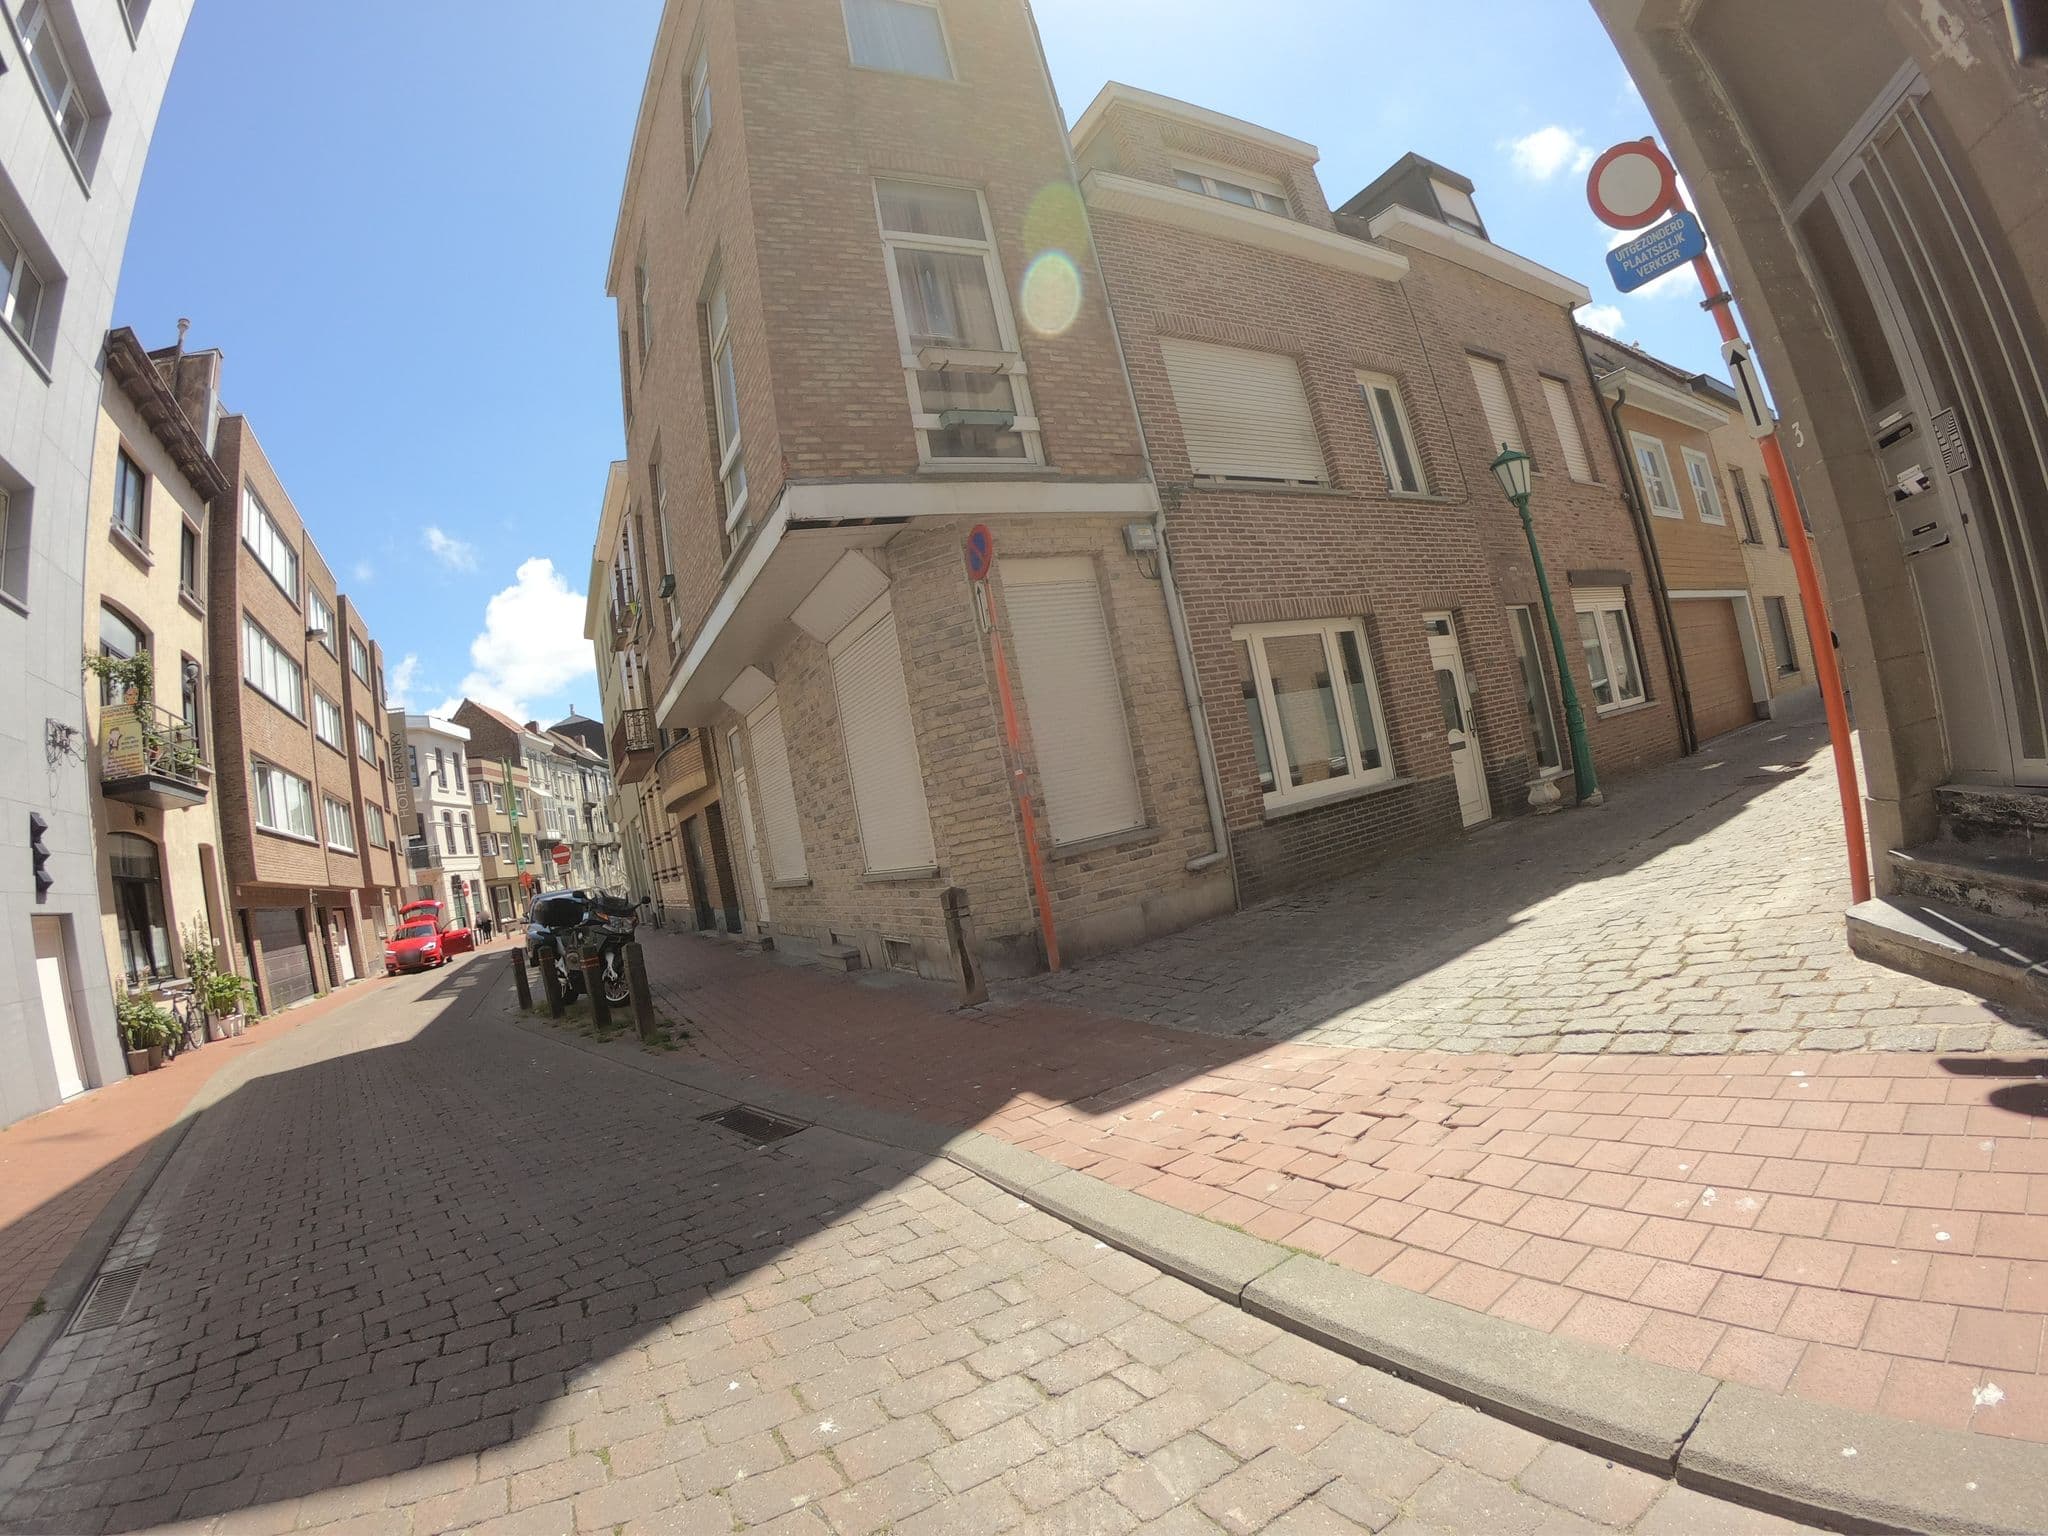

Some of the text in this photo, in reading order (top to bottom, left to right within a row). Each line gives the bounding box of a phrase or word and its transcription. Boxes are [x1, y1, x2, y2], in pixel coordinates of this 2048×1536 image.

[1615, 219, 1684, 262] UITGEZONDERD
[1622, 232, 1685, 271] PLAATSELIJK
[1636, 249, 1680, 277] VERKEER
[1791, 421, 1804, 448] 3
